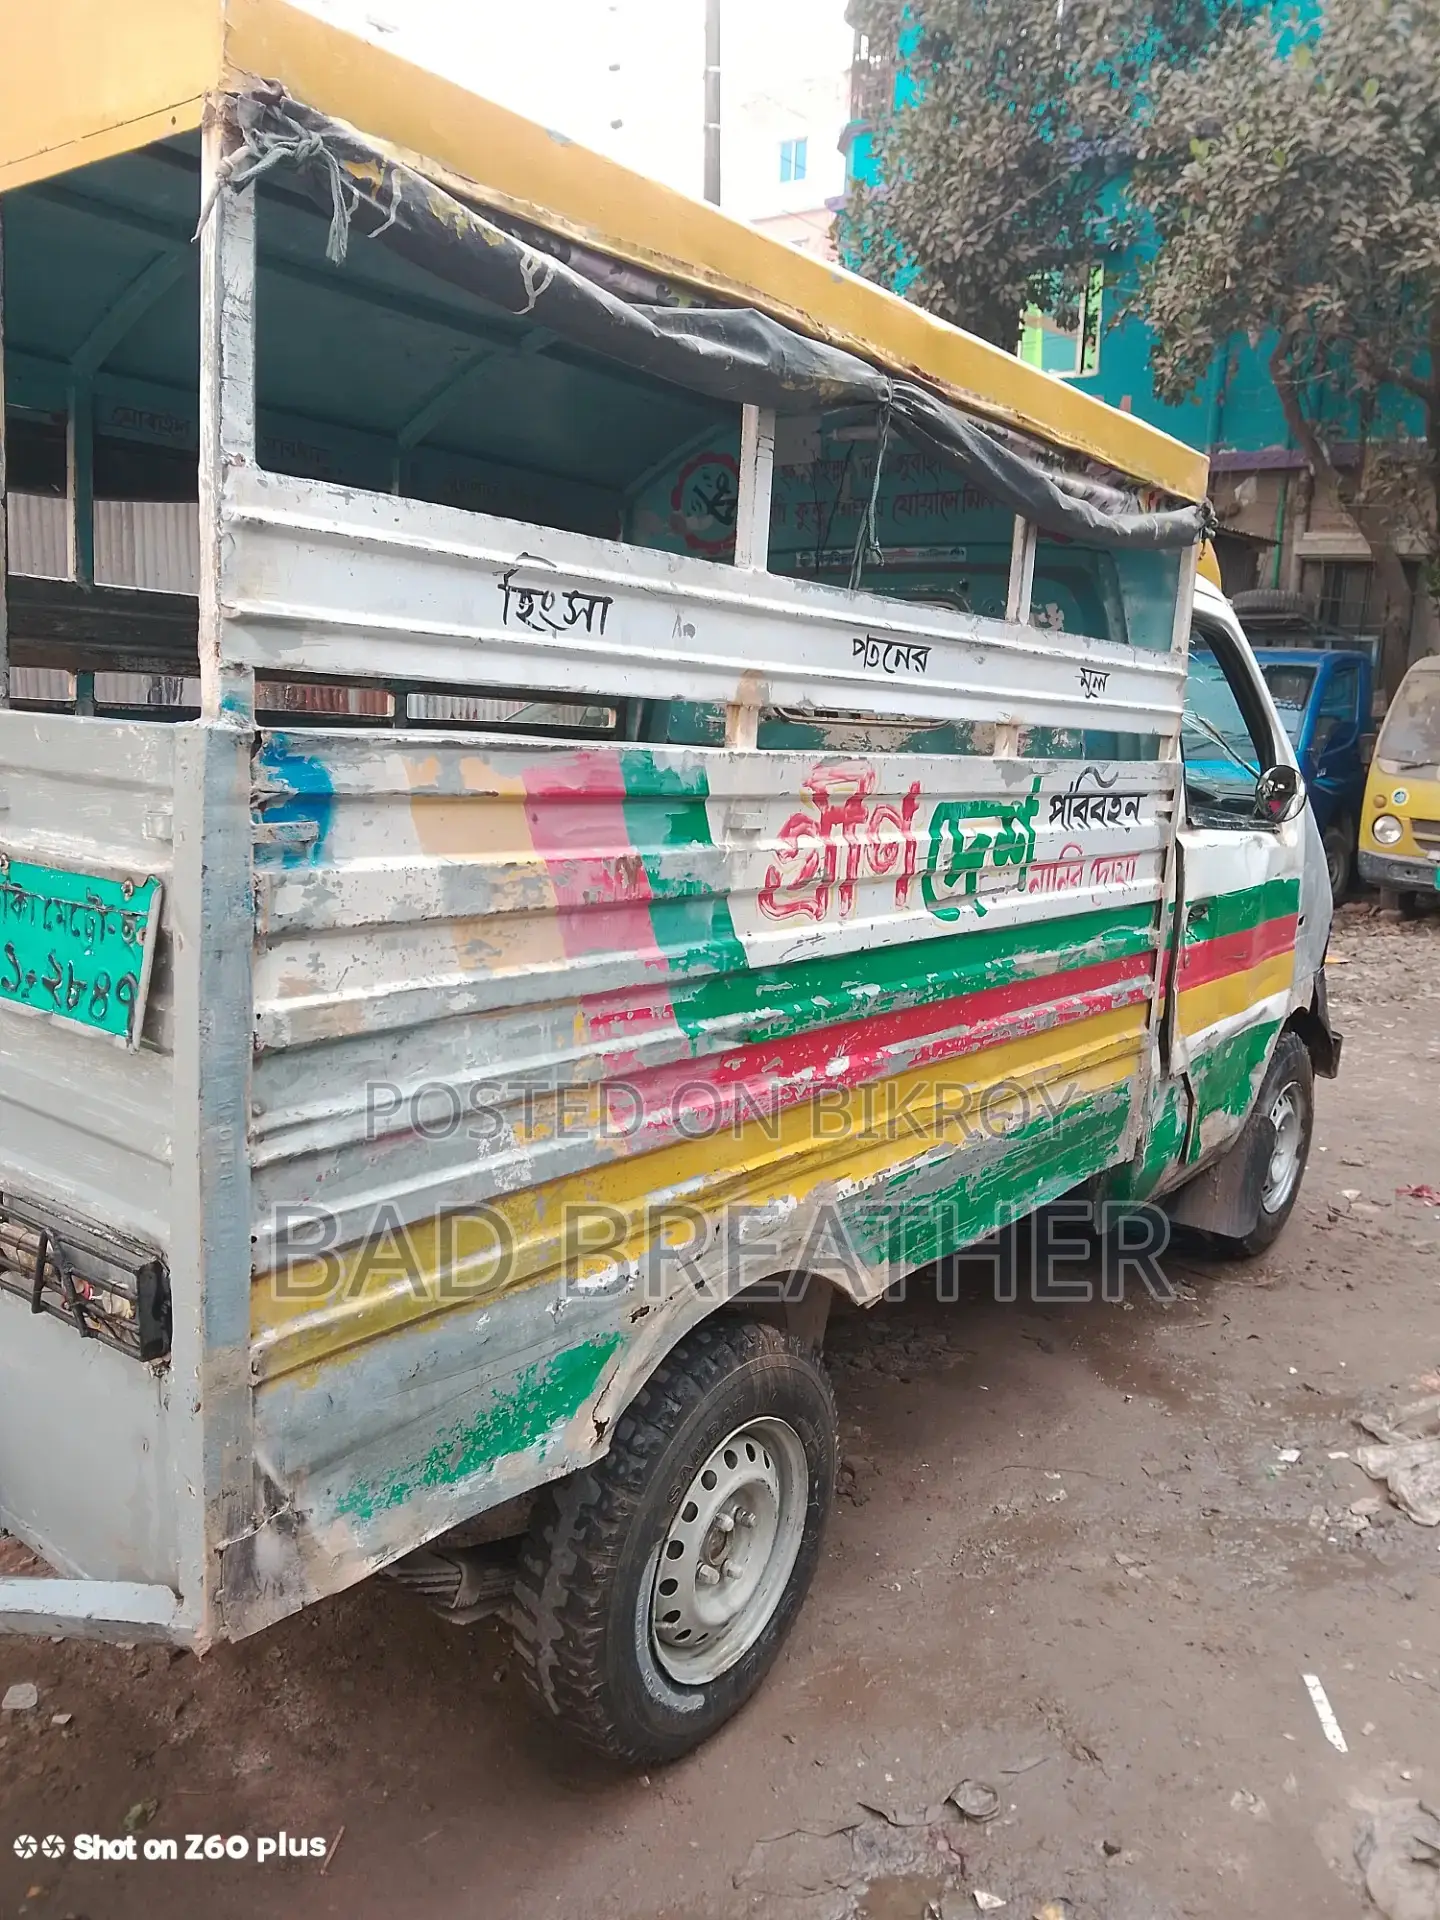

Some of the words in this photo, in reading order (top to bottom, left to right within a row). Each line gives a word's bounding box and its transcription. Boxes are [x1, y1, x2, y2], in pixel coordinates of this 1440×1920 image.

[494, 552, 613, 636] হিংসা
[853, 633, 932, 674] পতনের
[1075, 667, 1111, 699] মূল
[1048, 766, 1149, 832] পরিবহন
